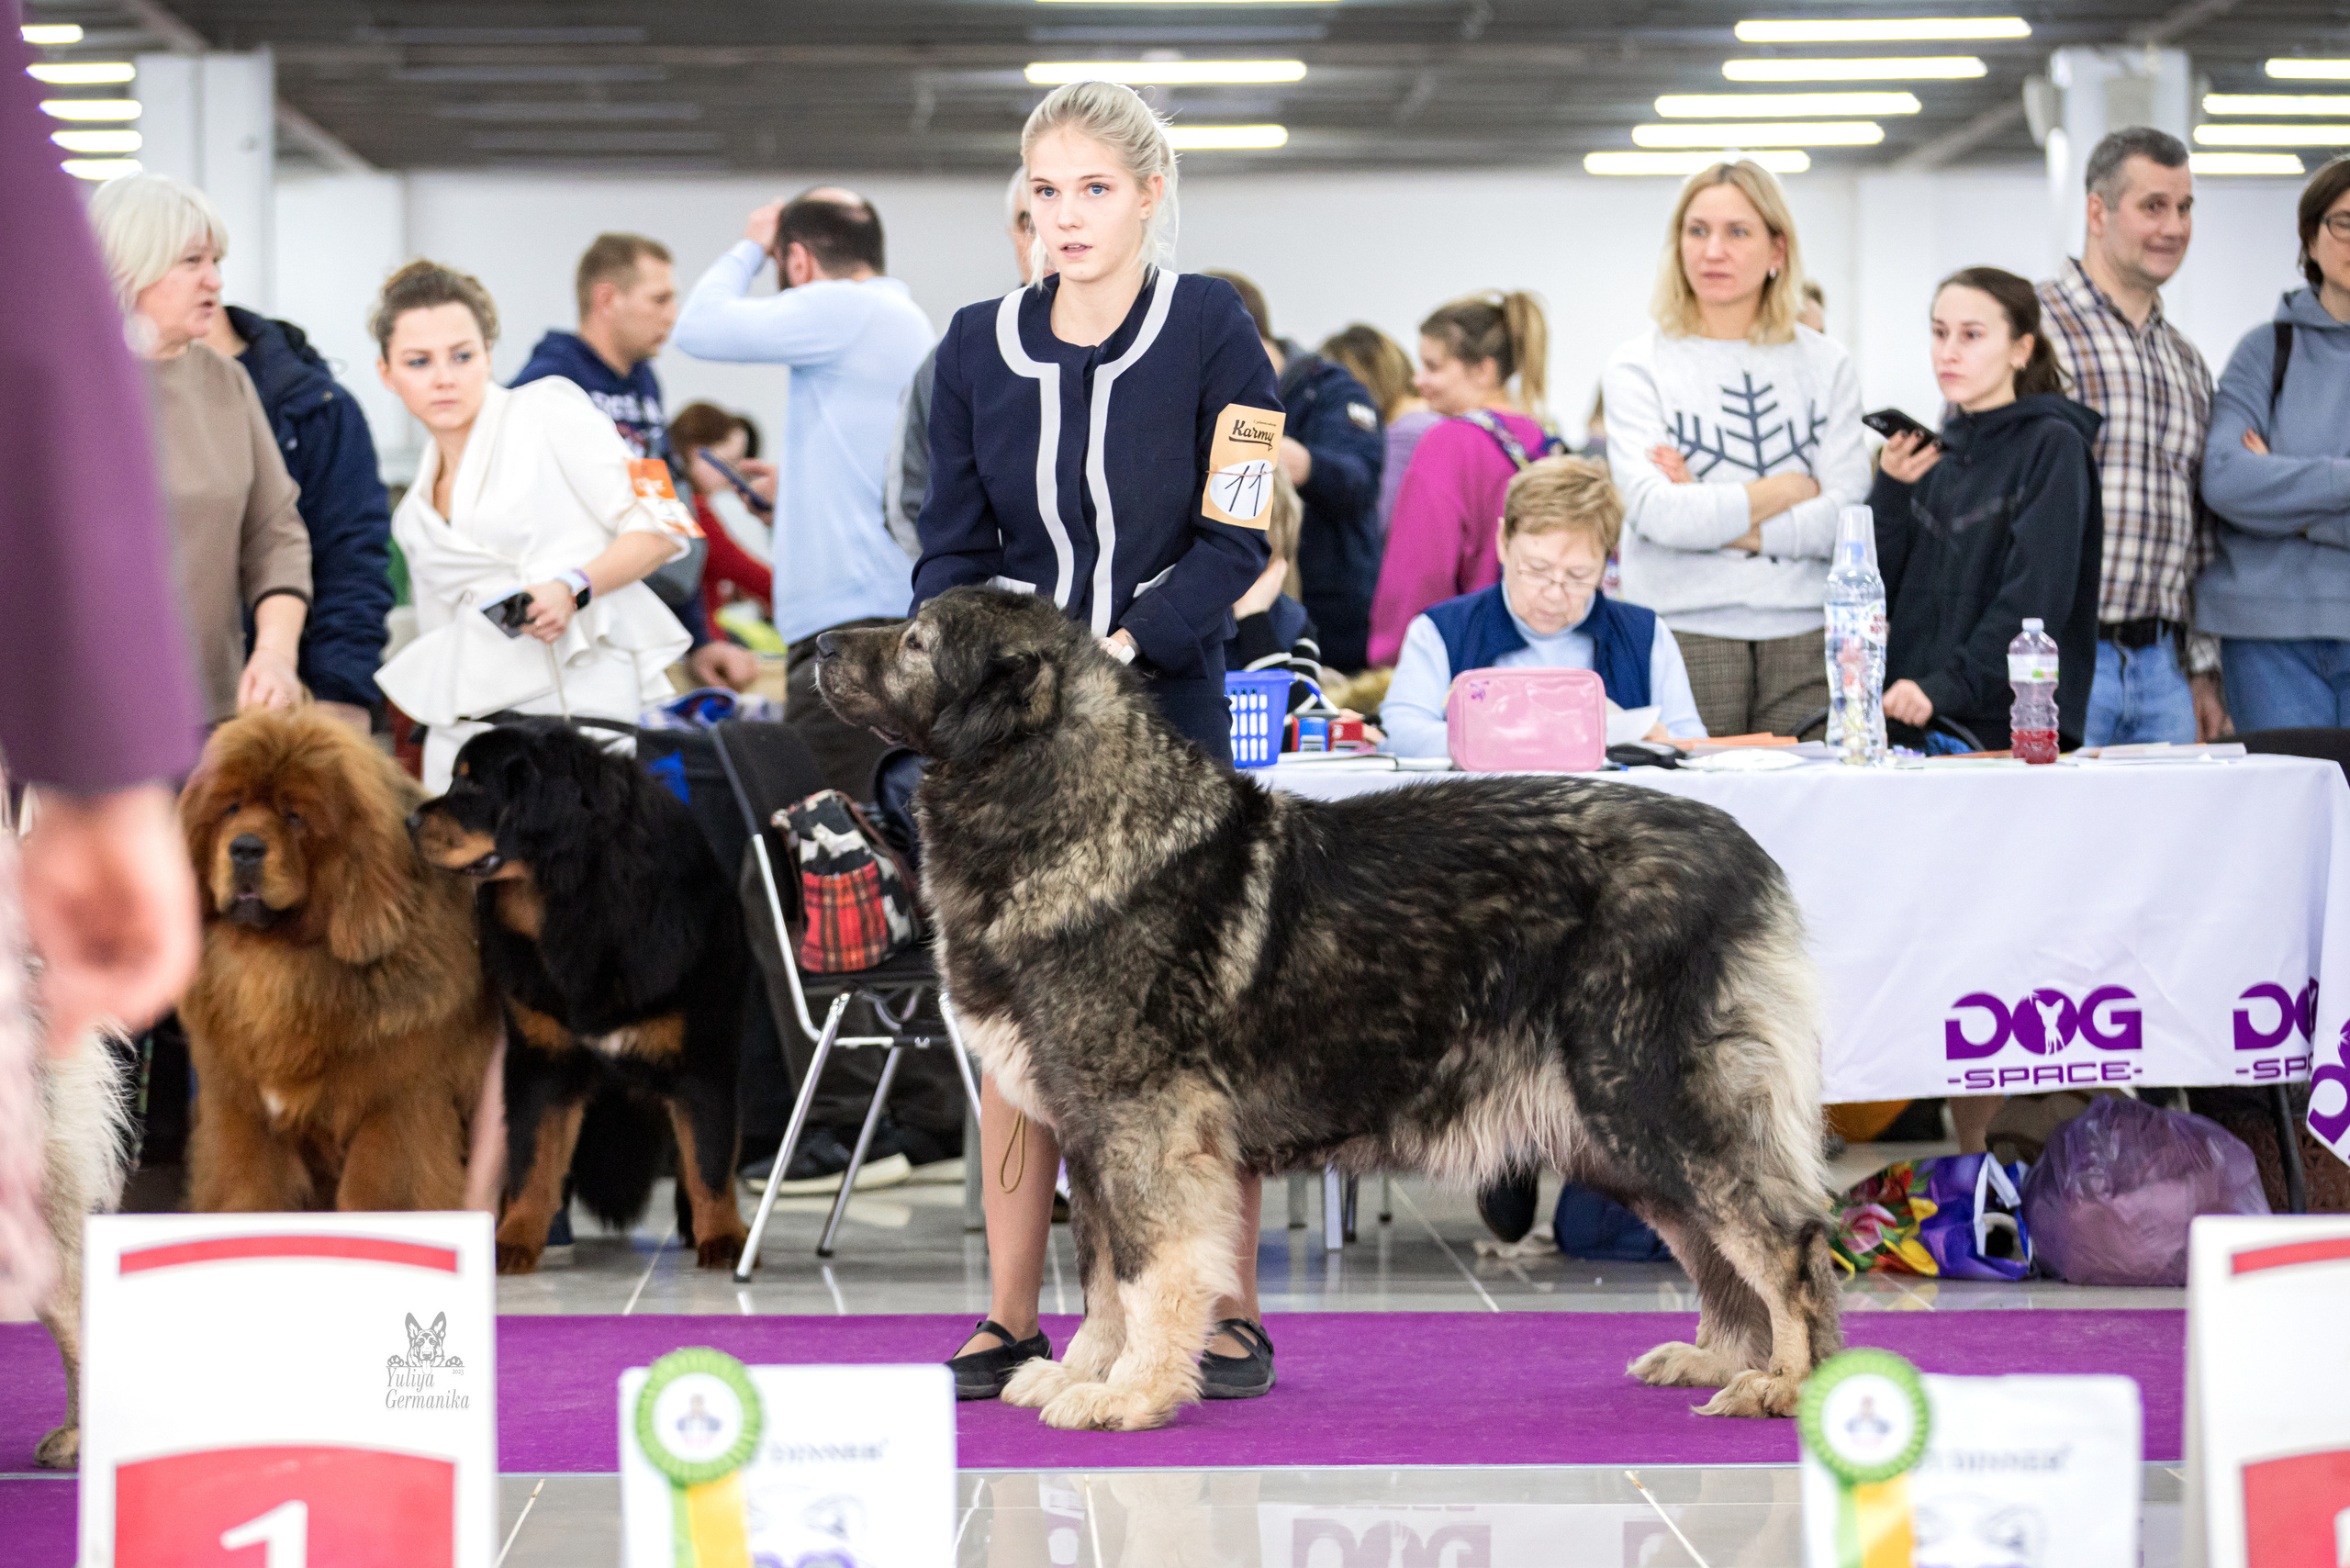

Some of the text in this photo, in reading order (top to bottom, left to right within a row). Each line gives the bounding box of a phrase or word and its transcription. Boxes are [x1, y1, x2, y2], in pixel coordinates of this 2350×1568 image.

[1231, 419, 1275, 447] Karmy
[1225, 463, 1266, 517] 11
[1944, 983, 2143, 1060] DOG
[219, 1498, 309, 1568] 1
